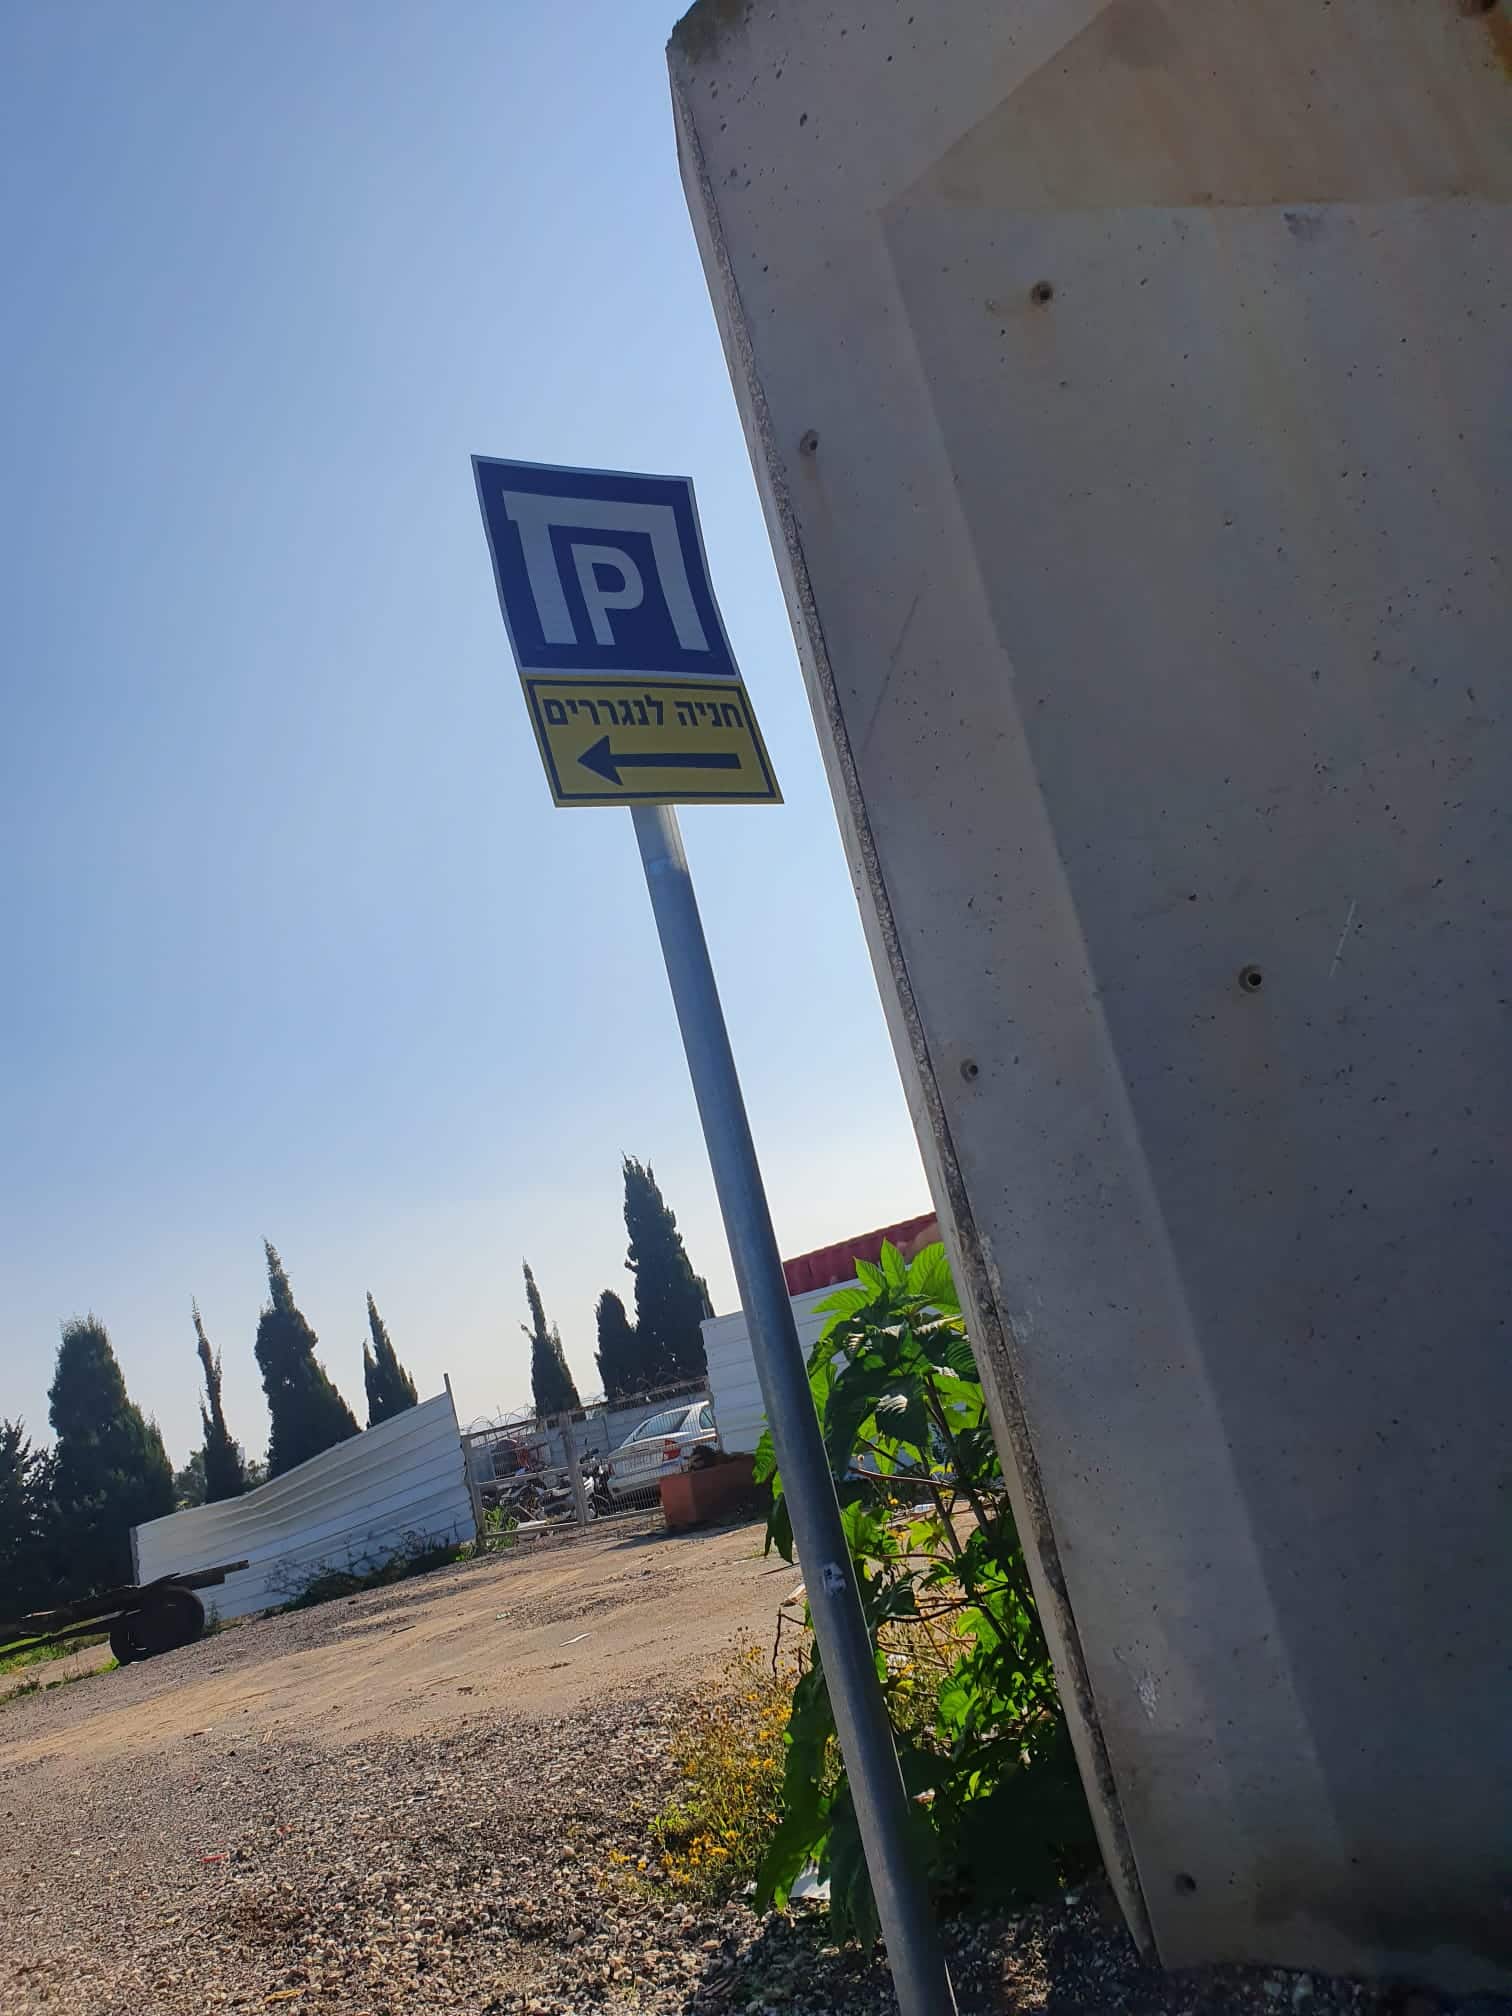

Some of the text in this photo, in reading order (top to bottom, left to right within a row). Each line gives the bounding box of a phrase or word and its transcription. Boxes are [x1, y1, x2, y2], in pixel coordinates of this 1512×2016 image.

[570, 543, 644, 646] P
[543, 694, 744, 728] חניה לנגררים
